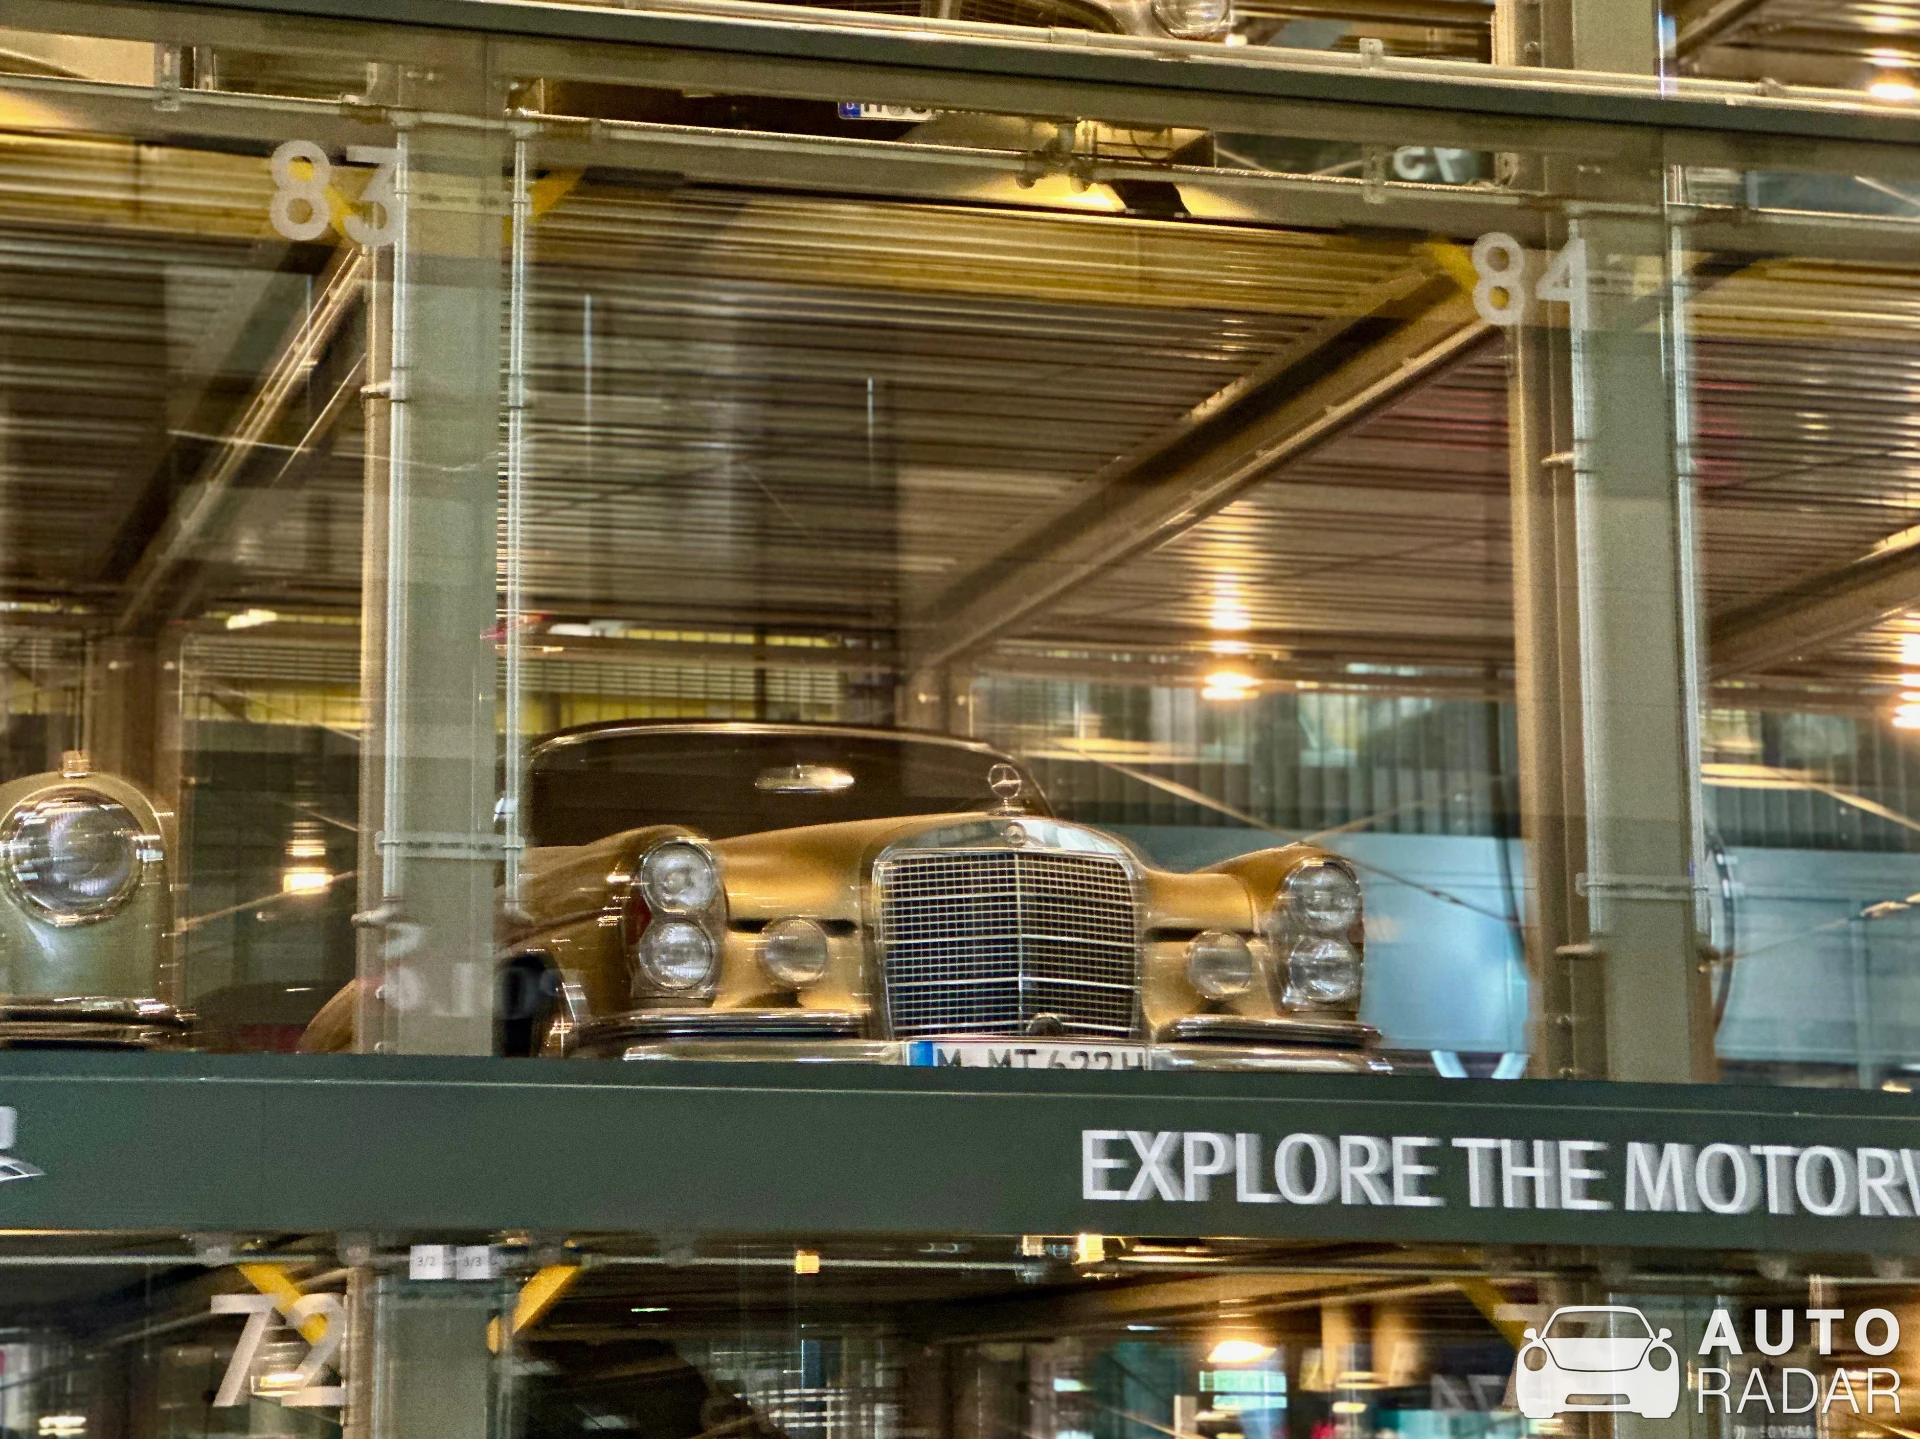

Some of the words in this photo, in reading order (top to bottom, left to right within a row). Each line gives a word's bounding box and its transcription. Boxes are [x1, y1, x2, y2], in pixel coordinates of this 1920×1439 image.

[270, 140, 403, 247] 83
[1472, 232, 1588, 331] 84
[1081, 1129, 1444, 1207] EXPLORE
[1452, 1137, 1612, 1211] THE
[210, 1292, 349, 1408] 72
